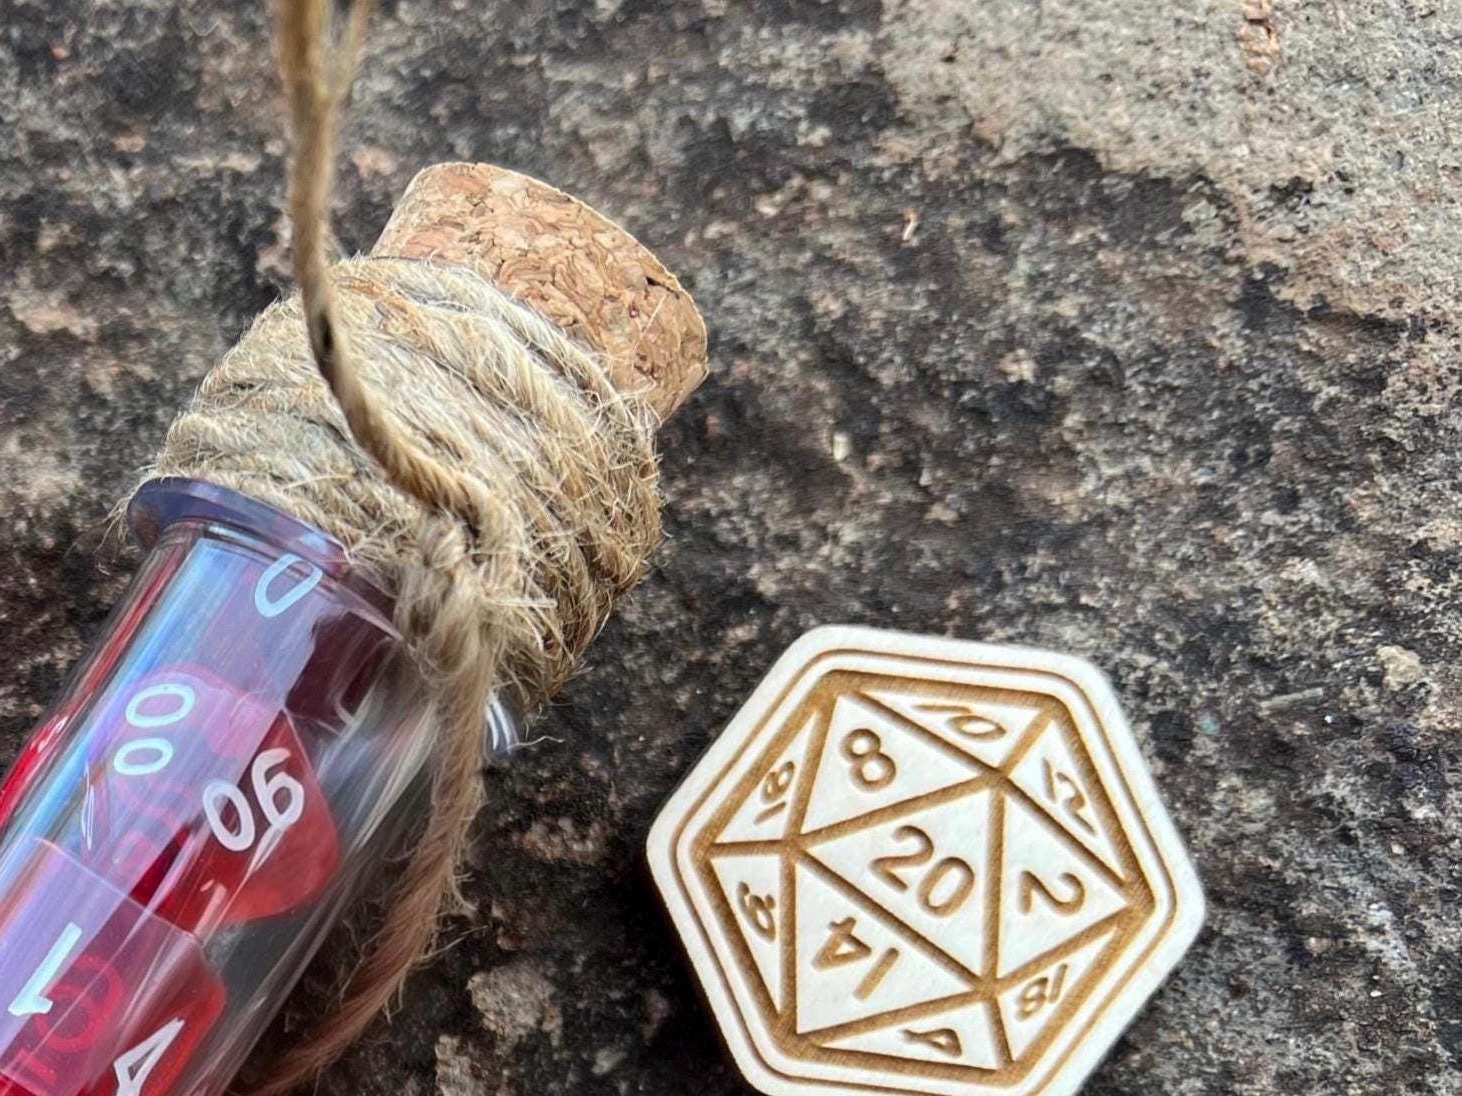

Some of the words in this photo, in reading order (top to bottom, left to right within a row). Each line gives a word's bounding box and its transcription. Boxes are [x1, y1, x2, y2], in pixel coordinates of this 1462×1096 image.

[113, 683, 195, 776] 00
[838, 727, 897, 792] 8
[911, 702, 1006, 742] 10
[1040, 757, 1099, 836] 12
[868, 824, 975, 918] 20
[1017, 869, 1088, 916] 2
[7, 921, 82, 1016] 1
[811, 916, 900, 1002] 14
[899, 1027, 962, 1058] 4
